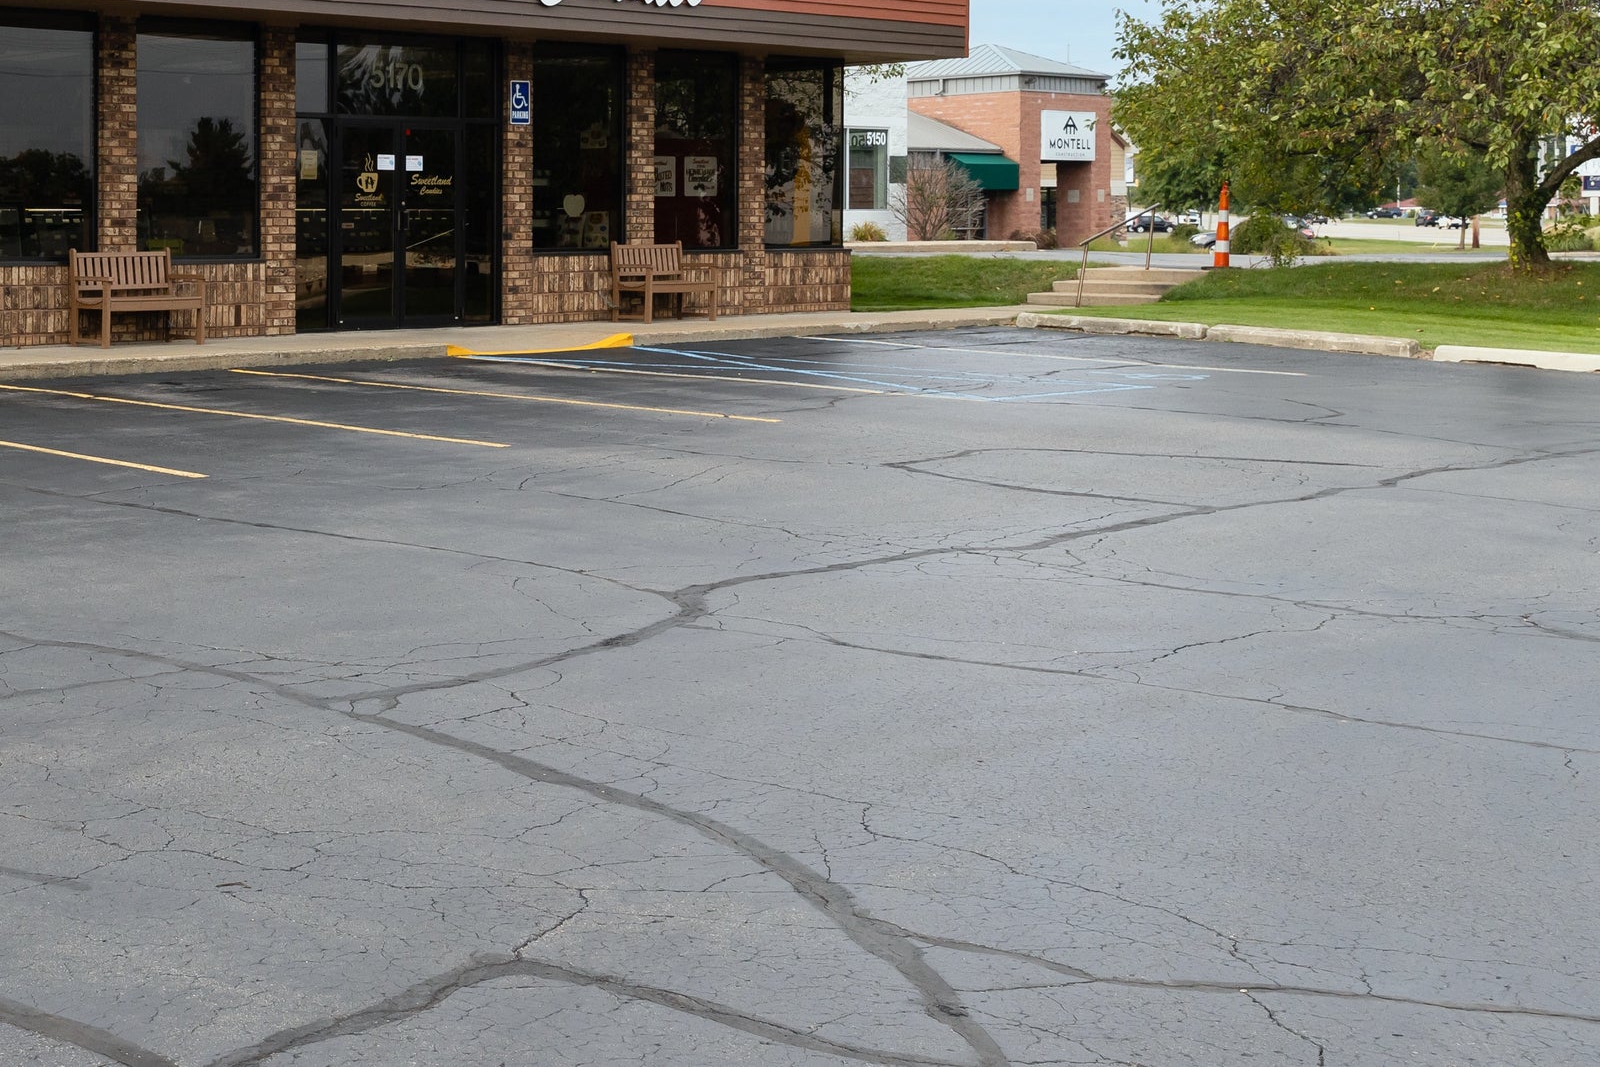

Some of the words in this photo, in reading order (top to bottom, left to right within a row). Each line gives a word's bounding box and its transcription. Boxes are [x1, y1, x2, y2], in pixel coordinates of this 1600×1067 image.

[370, 60, 423, 90] 5170
[512, 111, 529, 119] PARKING
[866, 131, 886, 145] 5150
[1049, 137, 1091, 150] MONTELL
[410, 174, 453, 185] Sweetland
